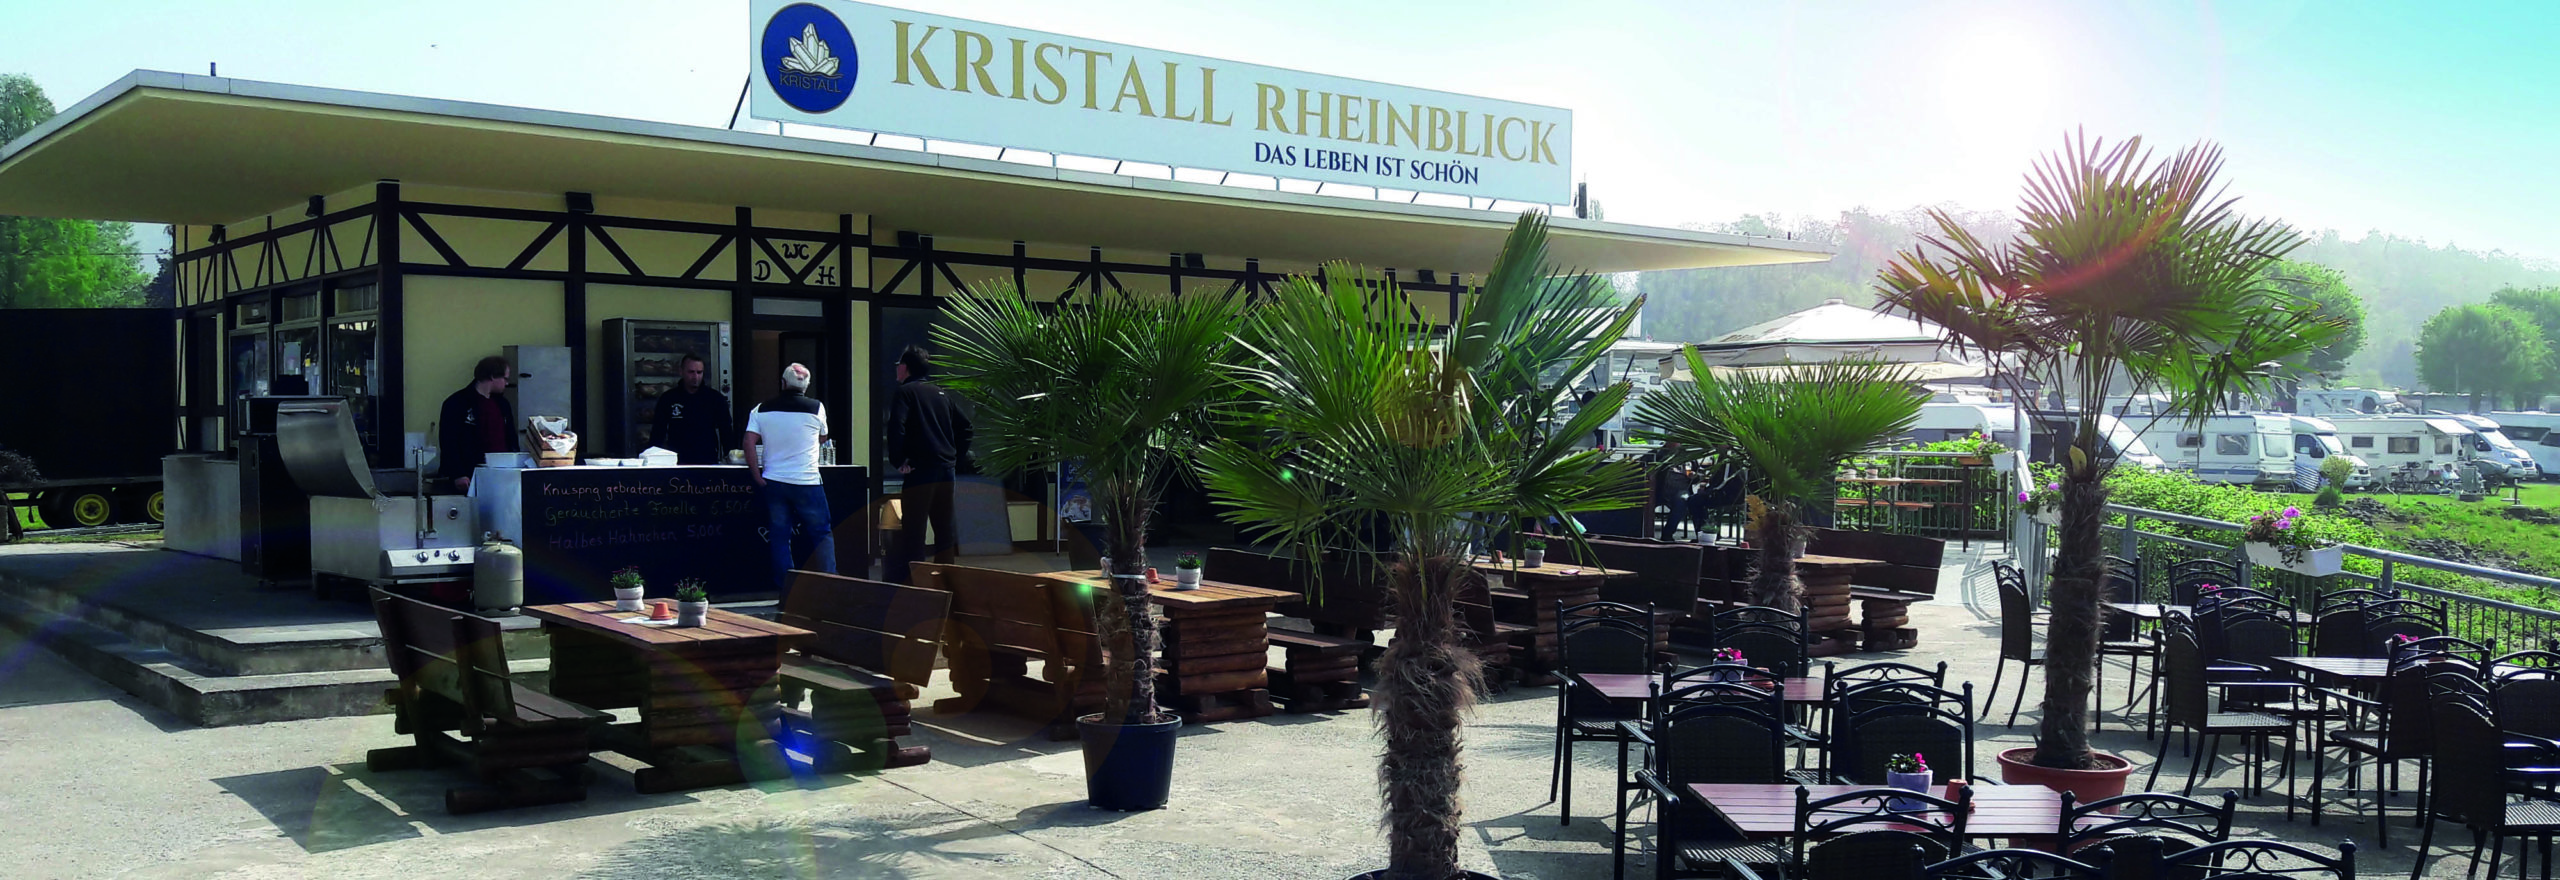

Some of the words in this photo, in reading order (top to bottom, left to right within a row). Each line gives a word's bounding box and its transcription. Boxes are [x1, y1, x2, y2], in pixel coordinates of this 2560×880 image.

[780, 73, 842, 93] KRISTALL
[890, 19, 1234, 127] KRISTALL
[1255, 82, 1559, 165] RHEINBLICK
[1255, 142, 1297, 166] DAS
[1304, 147, 1368, 173] LEBEN
[1375, 156, 1405, 177] IST
[1410, 159, 1479, 185] SCHÖN
[782, 243, 810, 260] WC
[754, 260, 771, 281] D
[815, 266, 836, 285] H
[606, 480, 664, 500] gebratene
[648, 500, 698, 516] Forelle
[549, 532, 603, 551] Halbes
